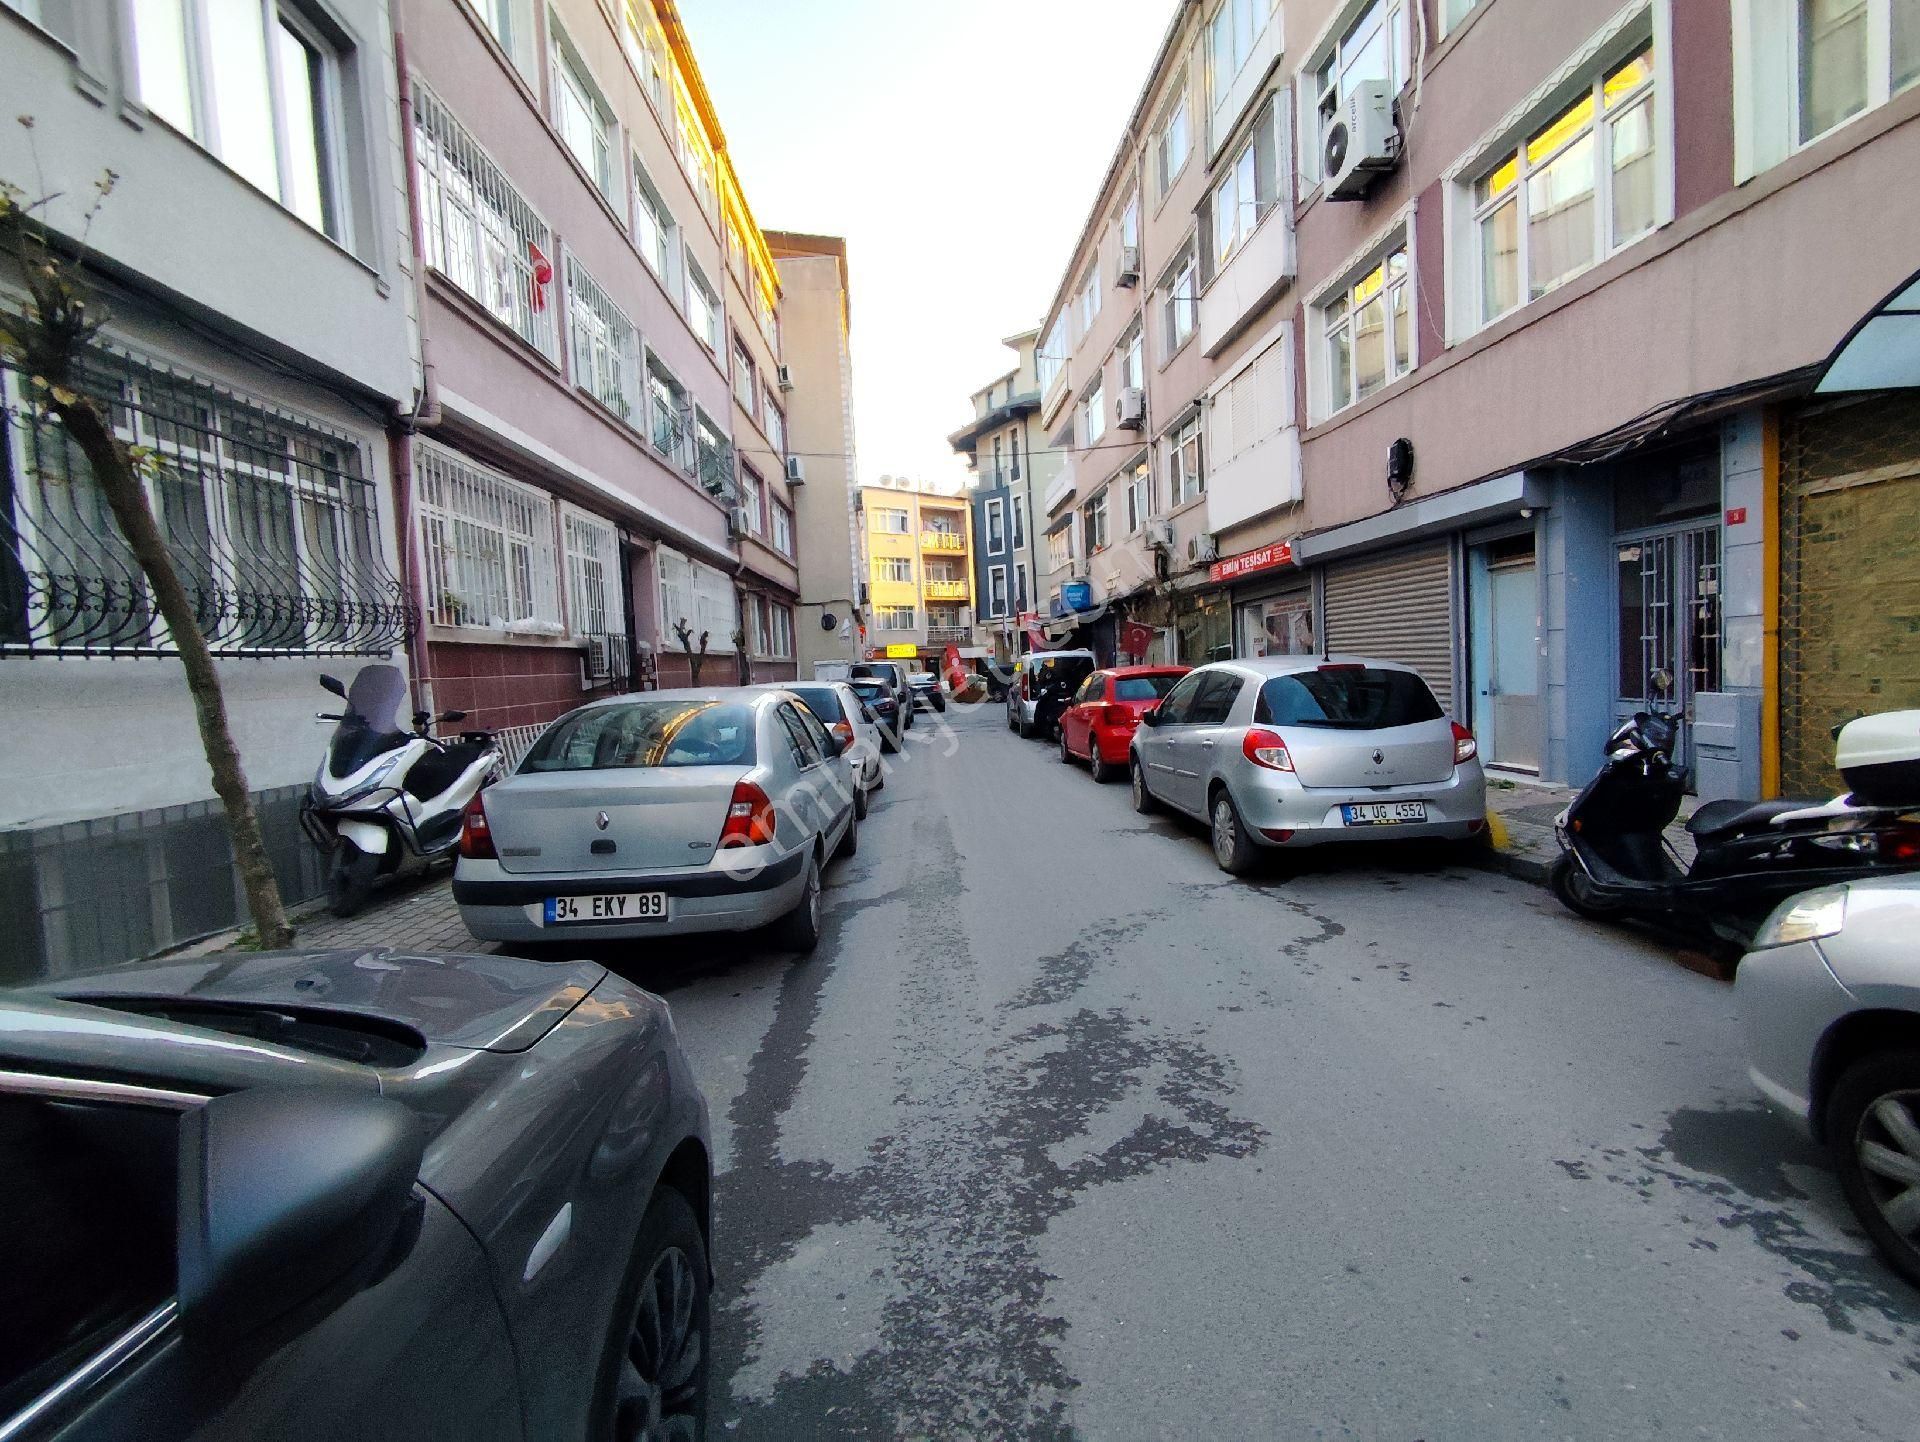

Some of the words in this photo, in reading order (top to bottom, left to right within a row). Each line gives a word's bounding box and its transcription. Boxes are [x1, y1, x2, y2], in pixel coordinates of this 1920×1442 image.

[1222, 558, 1239, 575] EMİN
[1241, 550, 1272, 568] TESİSAT
[1351, 807, 1366, 820] 34
[1372, 805, 1387, 818] UG
[1395, 803, 1423, 818] 4552
[556, 898, 578, 918] 34
[593, 896, 627, 917] EKY
[639, 894, 662, 915] 89
